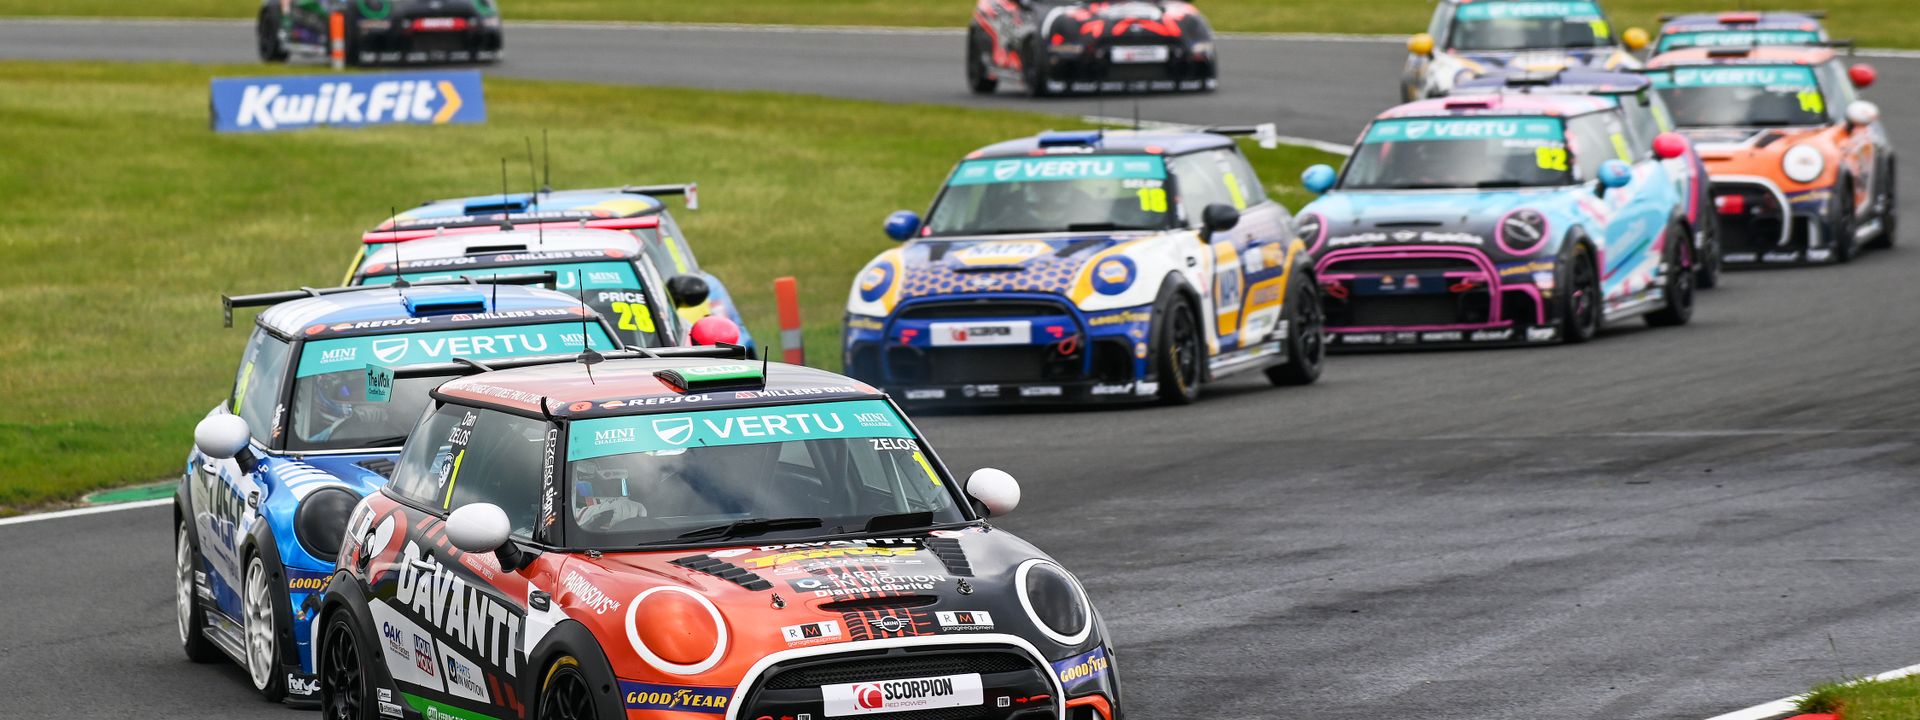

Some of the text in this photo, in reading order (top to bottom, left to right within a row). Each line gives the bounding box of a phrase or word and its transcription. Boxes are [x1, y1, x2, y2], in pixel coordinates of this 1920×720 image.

[1434, 121, 1517, 137] VERTU
[1024, 160, 1114, 177] VERTU
[411, 257, 477, 268] REPSOL
[514, 250, 603, 262] MILLERS OILS
[588, 272, 621, 281] MINI
[599, 292, 646, 304] PRICE
[473, 309, 567, 321] MILLERS OILS
[611, 301, 656, 333] 28
[352, 317, 430, 329] REPSOL
[418, 333, 548, 357] VERTU
[560, 333, 593, 344] MINI
[321, 347, 357, 360] MINI
[755, 384, 856, 399] MILLERS OILS
[628, 394, 712, 407] REPSOL
[462, 411, 476, 427] Dan
[854, 413, 888, 423] MINI
[703, 412, 844, 439] VERTU
[448, 427, 471, 446] ZELOS
[594, 427, 636, 440] MINI
[869, 438, 920, 451] ZELOS
[912, 451, 942, 487] 1
[443, 449, 465, 510] 1
[760, 537, 918, 551] DAVANTI
[828, 570, 890, 580] PARTS
[832, 574, 947, 588] IN MOTION
[563, 570, 613, 615] PARKINSON'S
[815, 583, 934, 598] Diamondbrite
[397, 540, 521, 678] DAVANTI
[384, 621, 401, 645] OAK
[884, 678, 954, 700] SCORPION
[900, 700, 926, 708] POWER
